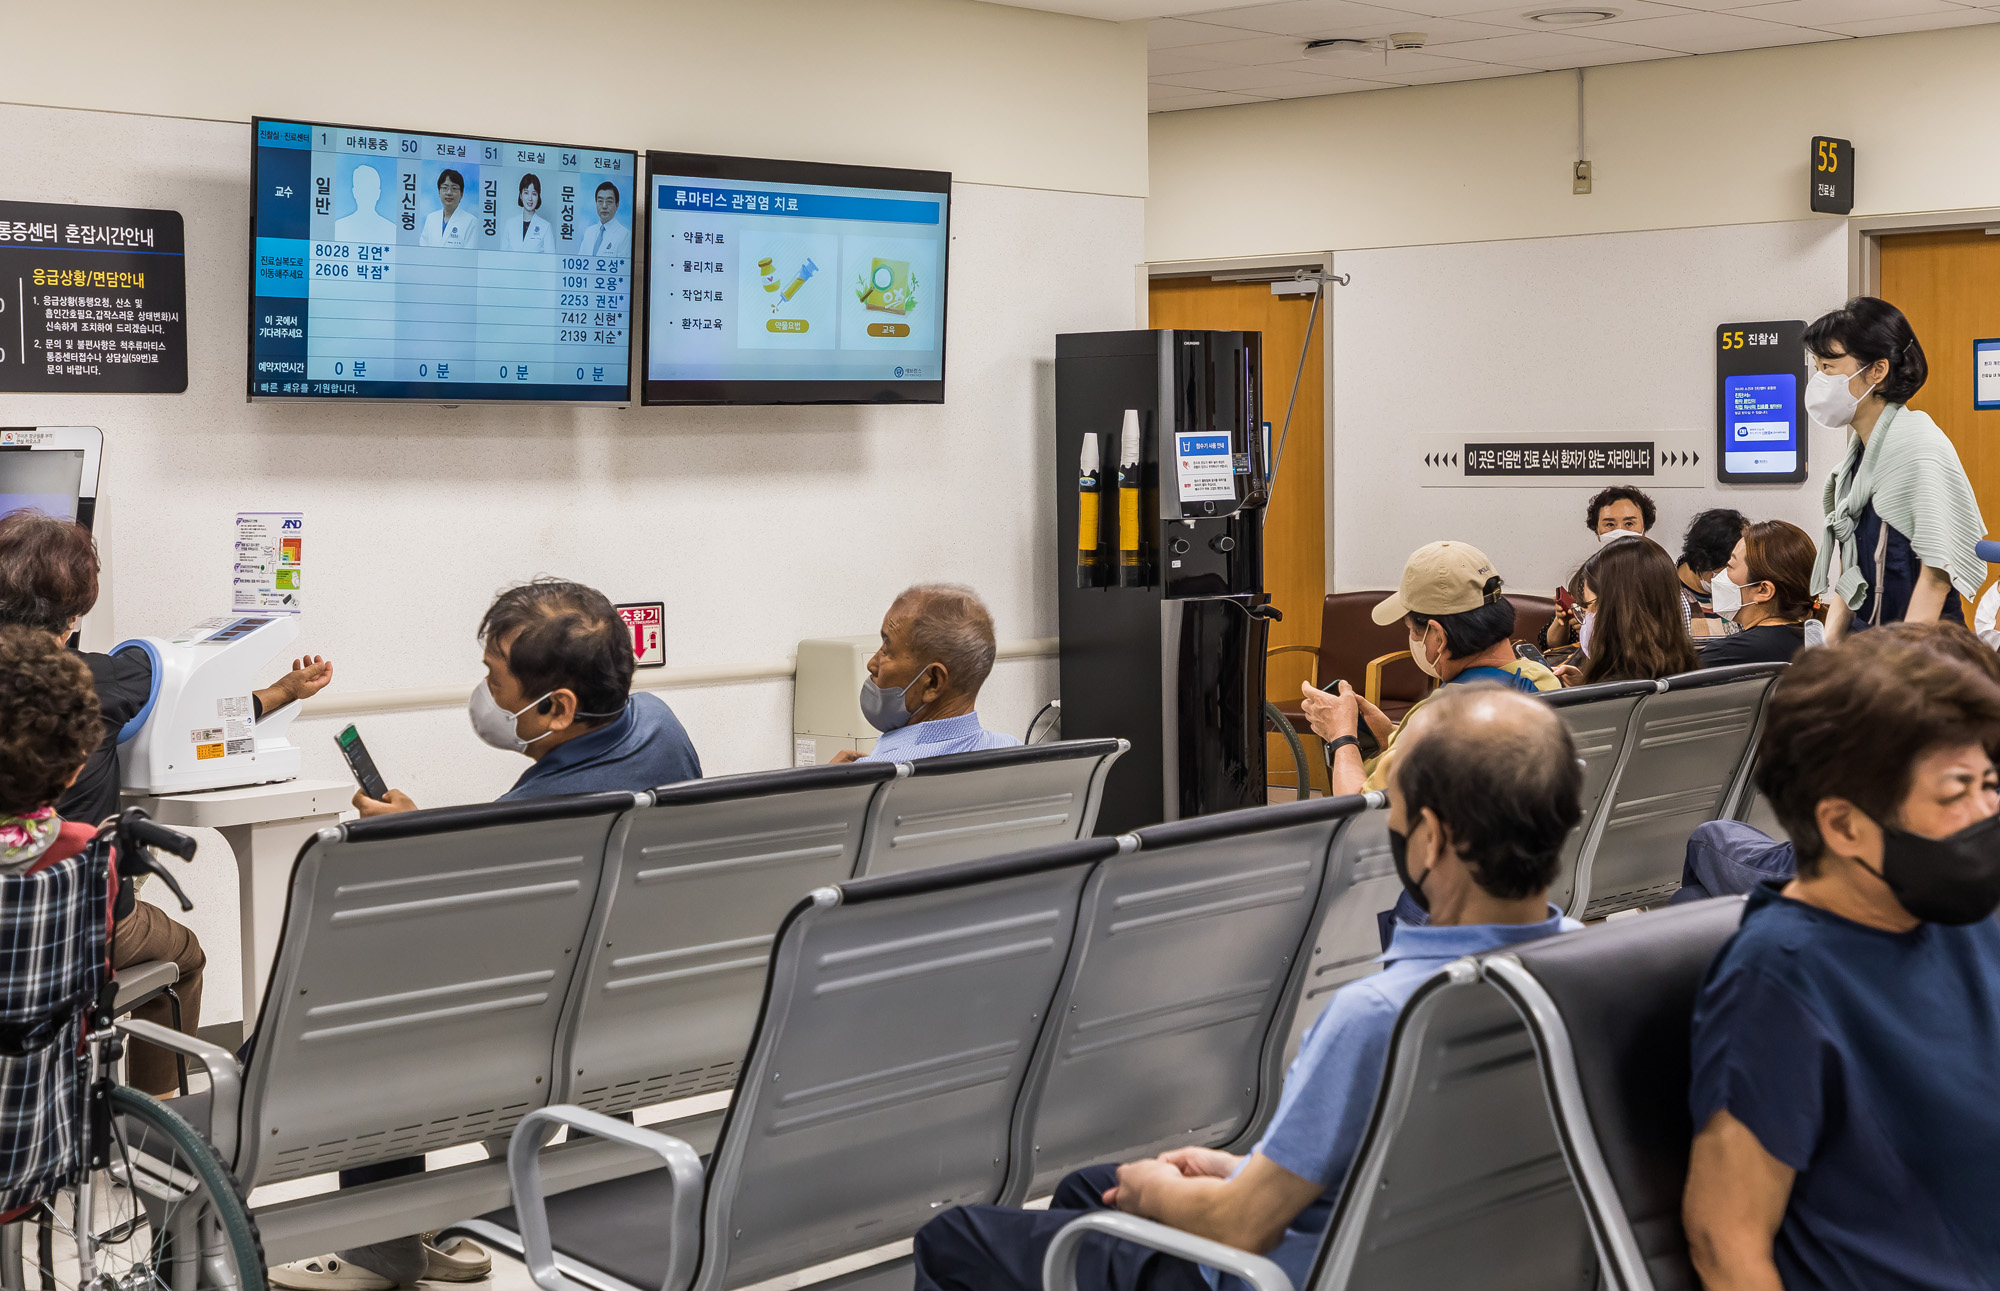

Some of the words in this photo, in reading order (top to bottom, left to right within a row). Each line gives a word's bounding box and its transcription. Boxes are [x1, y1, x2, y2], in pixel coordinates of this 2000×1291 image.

[260, 130, 279, 140] 진찰실
[284, 133, 310, 143] 진료센터
[321, 133, 327, 145] 1
[346, 136, 389, 150] 마취통증
[401, 140, 418, 153] 50
[436, 144, 466, 157] 진료실
[484, 147, 498, 160] 51
[517, 150, 545, 164] 진료실
[562, 154, 577, 166] 54
[594, 157, 621, 170] 진료실
[1818, 141, 1837, 173] 55
[275, 186, 294, 198] 교수
[316, 177, 330, 215] 일반
[1818, 184, 1835, 198] 진료실
[401, 174, 416, 230] 김신형
[674, 190, 727, 208] 류마티스
[731, 193, 770, 211] 관절염
[774, 196, 799, 212] 치료
[483, 180, 497, 236] 김희정
[560, 186, 575, 240] 문성환
[0, 221, 58, 243] 통증센터
[65, 224, 154, 247] 혼잡시간안내
[684, 232, 724, 244] 약물치료
[316, 244, 349, 258] 8028
[260, 257, 304, 267] 진료실복도로
[562, 259, 589, 271] 1092
[683, 261, 724, 273] 물리치료
[260, 268, 304, 279] 이동해주세요
[316, 263, 349, 277] 2606
[32, 268, 145, 288] 응급상황/면담안내
[562, 276, 588, 288] 1091
[560, 294, 588, 306] 2253
[682, 289, 724, 302] 작업치료
[33, 297, 39, 306] 1.
[116, 299, 131, 307] 산소
[135, 299, 143, 308] 및
[265, 315, 272, 325] 이
[275, 316, 298, 326] 곳에서
[561, 313, 587, 324] 7412
[681, 317, 723, 331] 환자교육
[46, 322, 78, 332] 신속하게
[81, 323, 113, 333] 조치하여
[116, 324, 165, 334] 드리겠습니다.
[259, 328, 303, 338] 기다려주세요
[882, 326, 895, 335] 교육
[560, 330, 587, 342] 2139
[1722, 331, 1744, 350] 55
[1748, 333, 1778, 345] 진찰실
[34, 340, 42, 349] 2.
[45, 340, 62, 349] 문의
[66, 340, 73, 350] 및
[77, 340, 116, 350] 불편사항은
[46, 352, 102, 363] 통증센터접수나
[106, 353, 159, 363] 상담실(59번)로
[47, 365, 63, 374] 문의
[67, 365, 101, 375] 바랍니다.
[258, 362, 304, 373] 예약지연시간
[335, 362, 343, 375] 0
[353, 361, 366, 377] 분
[419, 364, 427, 377] 0
[436, 363, 449, 379] 분
[500, 366, 507, 378] 0
[516, 365, 528, 380] 분
[576, 368, 584, 380] 0
[592, 367, 604, 382] 분
[260, 382, 278, 392] 빠른
[283, 383, 309, 394] 쾌유를
[314, 384, 358, 394] 기원합니다.
[1468, 450, 1476, 469] 이
[1479, 450, 1495, 469] 곳은
[1497, 450, 1521, 469] 다음번
[1524, 450, 1540, 468] 진료
[1542, 450, 1558, 469] 순서
[1561, 449, 1586, 469] 환자가
[1588, 449, 1605, 468] 앉는
[1607, 449, 1650, 469] 자리입니다
[282, 520, 302, 529] AND
[620, 609, 658, 621] 소화기
